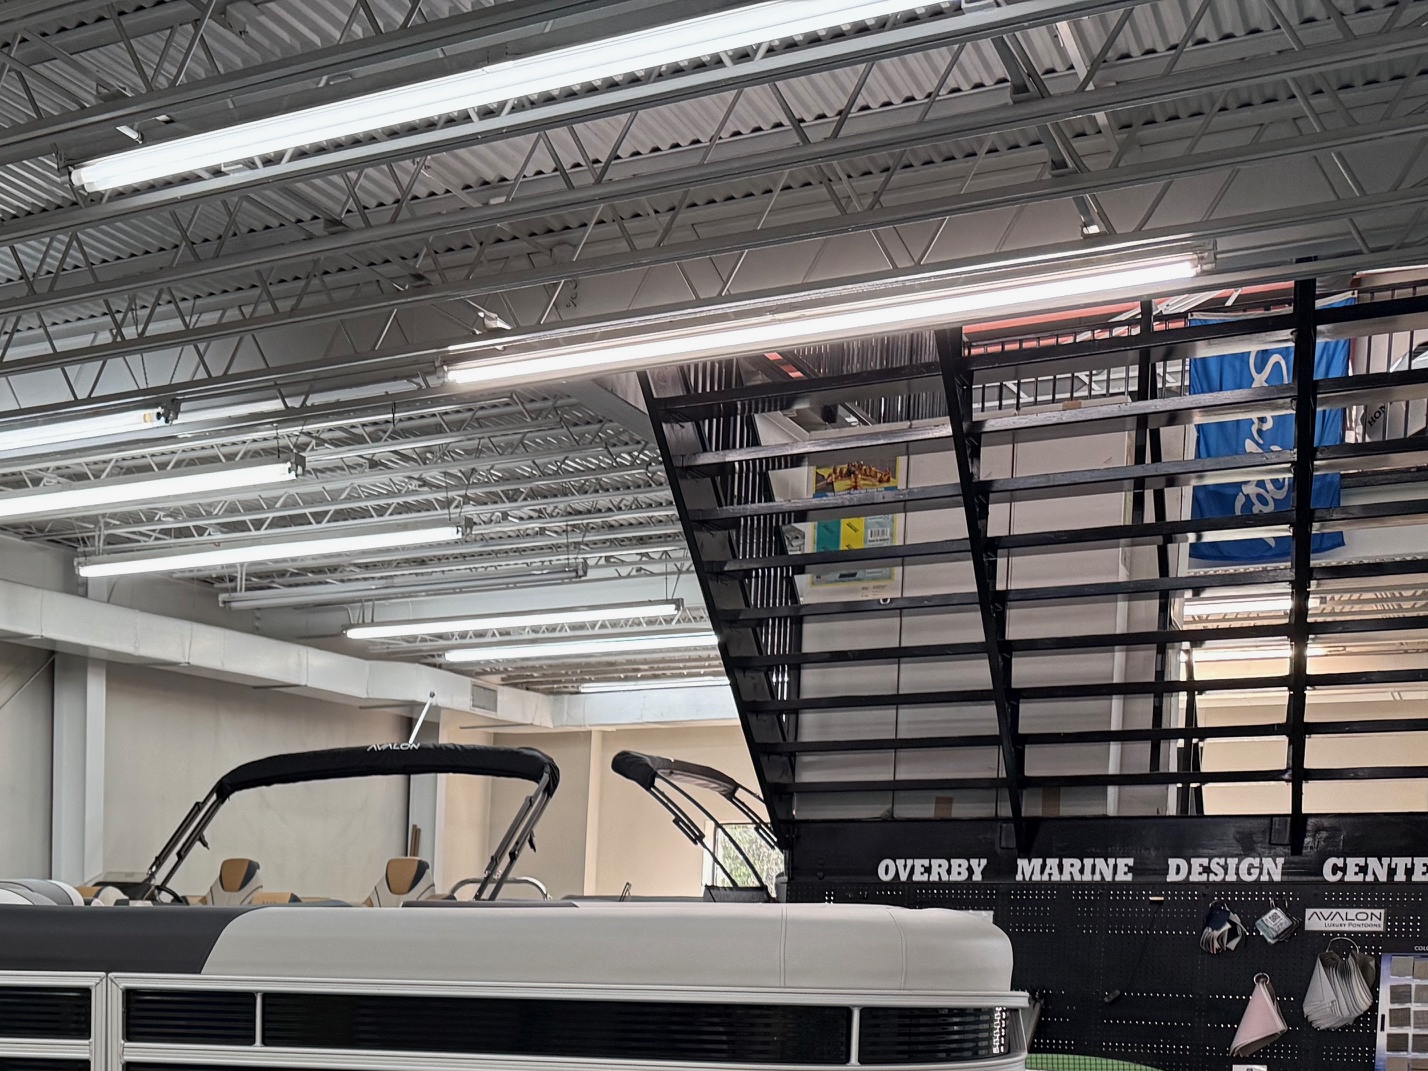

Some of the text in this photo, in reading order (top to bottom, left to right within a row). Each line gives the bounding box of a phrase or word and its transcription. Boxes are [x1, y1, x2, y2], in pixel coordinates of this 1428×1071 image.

[366, 742, 421, 752] AVALON
[877, 858, 988, 882] OVERBY
[1015, 857, 1135, 882] MARINE
[1166, 857, 1285, 882] DESIGN
[1307, 911, 1382, 922] AVALON
